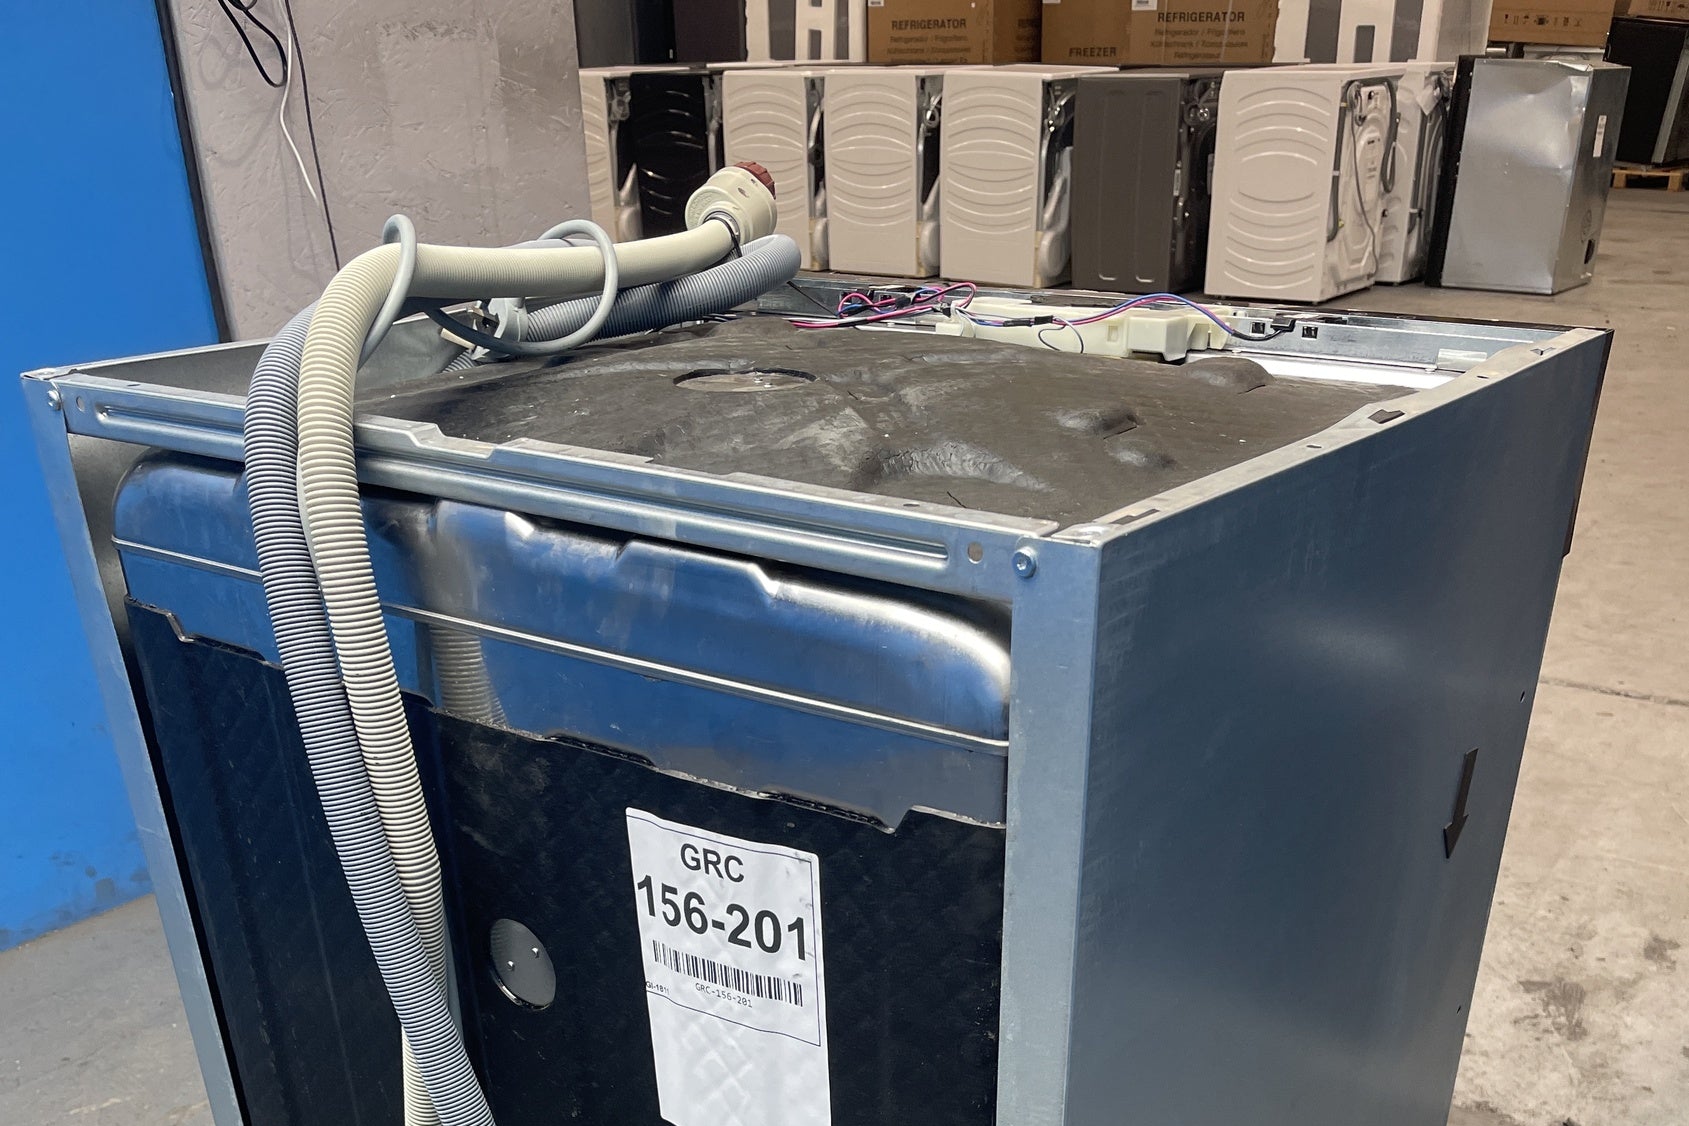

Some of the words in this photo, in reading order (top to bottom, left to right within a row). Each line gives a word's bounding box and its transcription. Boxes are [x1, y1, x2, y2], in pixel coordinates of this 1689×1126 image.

[891, 18, 967, 30] REFRIGERATOR
[1157, 11, 1245, 23] REFRIGERATOR
[1068, 46, 1117, 58] FREEZER
[680, 843, 744, 883] GRC
[637, 874, 806, 961] 156-201
[695, 982, 752, 1008] GRC-156-201
